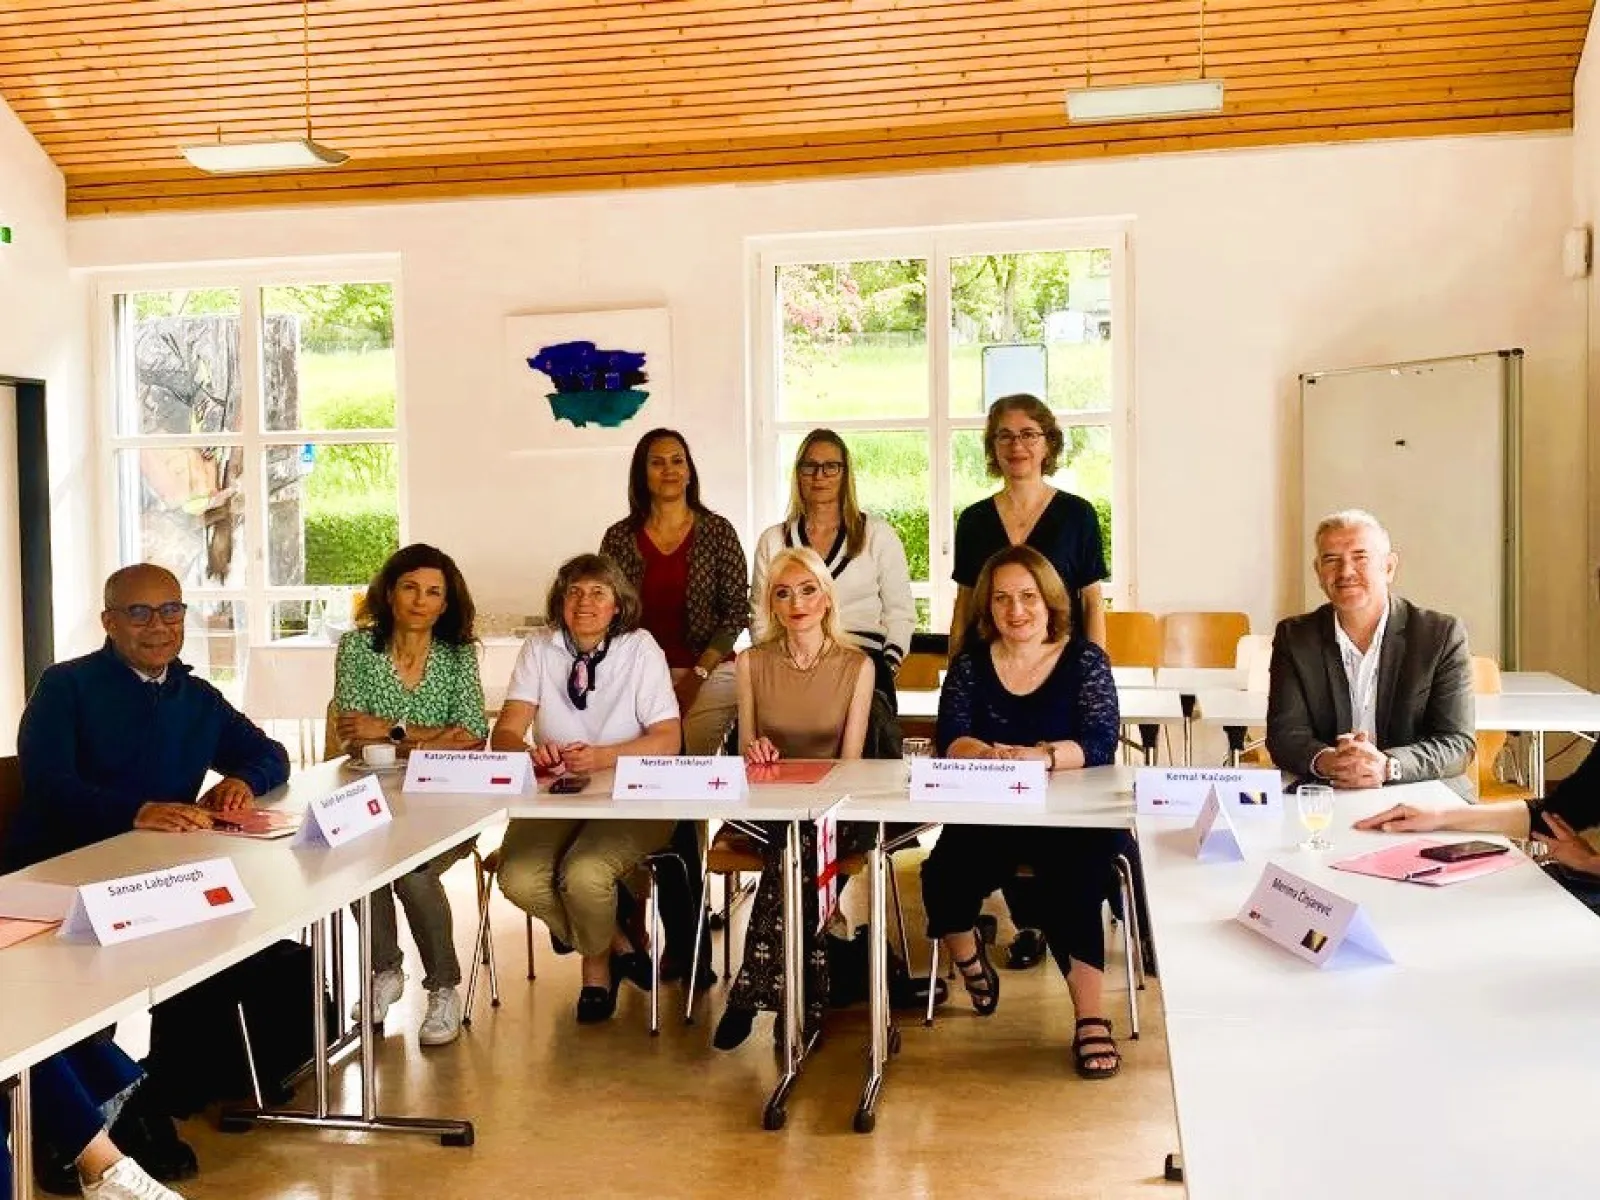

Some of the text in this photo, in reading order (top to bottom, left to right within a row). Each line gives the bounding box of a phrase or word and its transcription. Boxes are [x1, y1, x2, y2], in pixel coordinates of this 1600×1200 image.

[640, 758, 673, 766] Nestan
[932, 762, 966, 771] Marika
[1166, 773, 1199, 781] Kemal
[107, 882, 143, 897] Sanae
